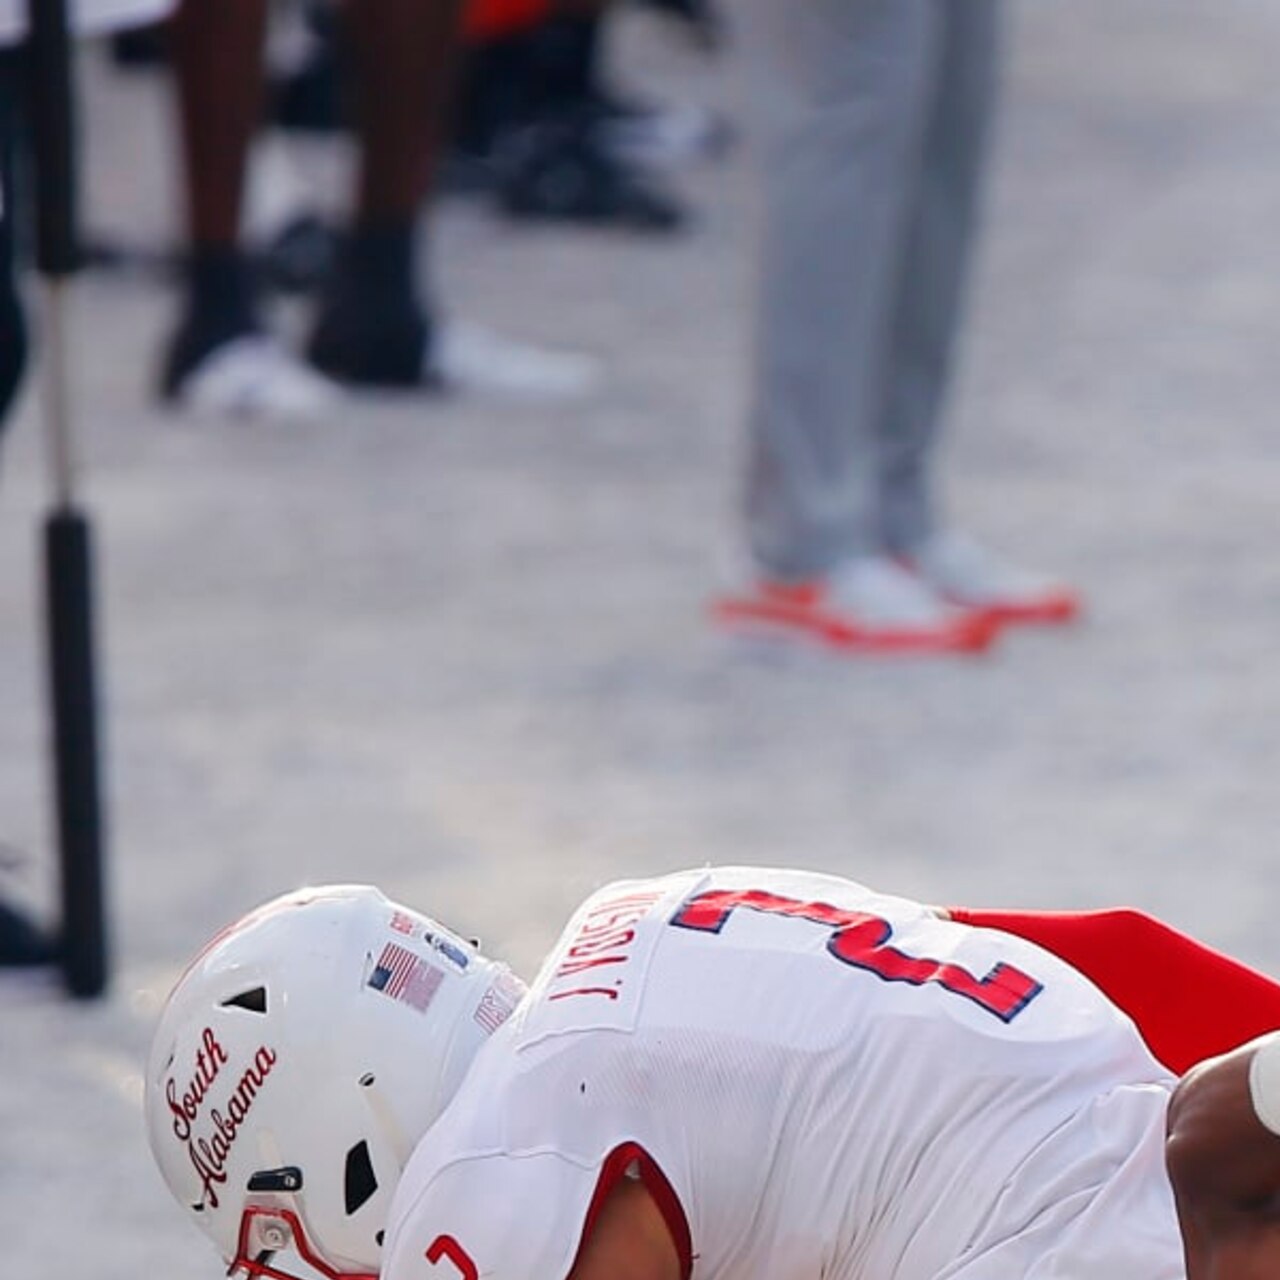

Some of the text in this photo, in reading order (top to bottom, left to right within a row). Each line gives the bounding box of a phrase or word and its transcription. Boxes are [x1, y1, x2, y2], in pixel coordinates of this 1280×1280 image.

[669, 888, 1045, 1025] 2
[166, 1026, 228, 1141] South
[188, 1045, 277, 1209] Alabama
